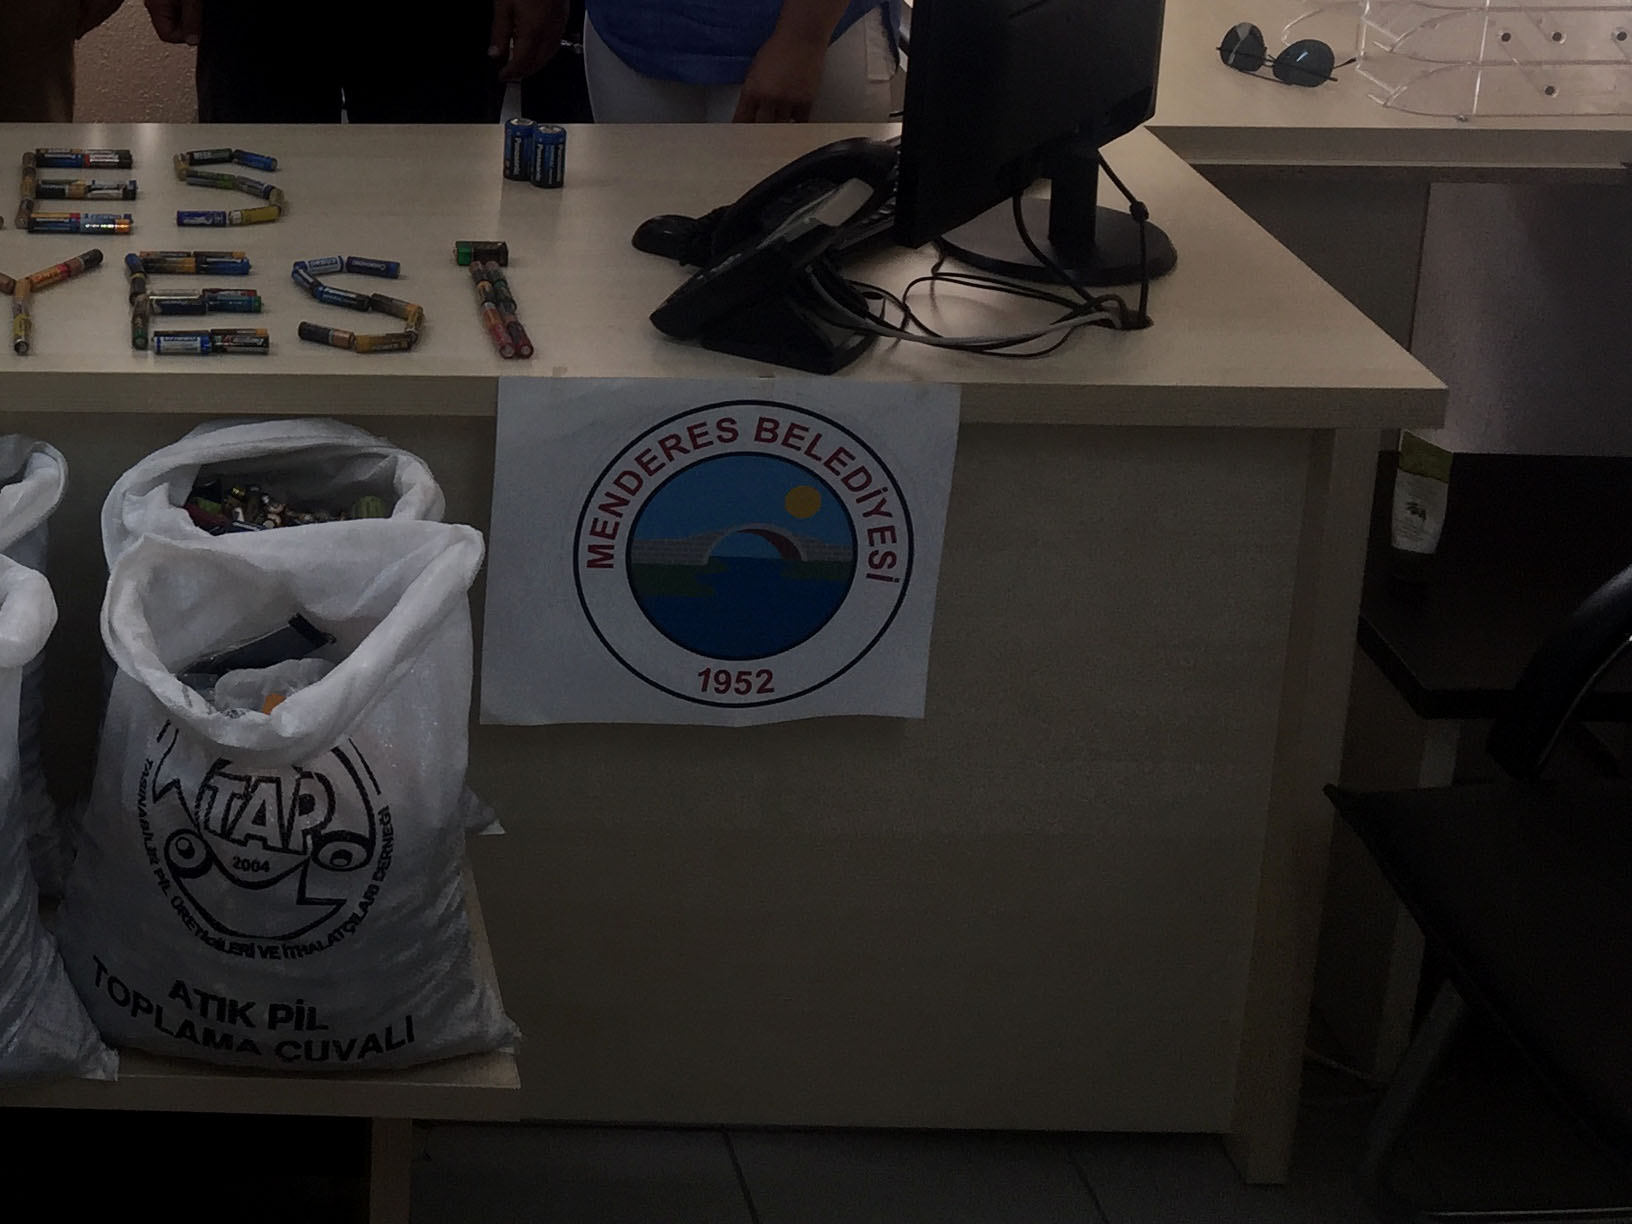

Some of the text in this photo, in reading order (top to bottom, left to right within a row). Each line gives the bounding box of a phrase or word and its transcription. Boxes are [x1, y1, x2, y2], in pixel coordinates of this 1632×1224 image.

[585, 415, 900, 584] MENDERES BELEDİYESİ
[697, 667, 775, 695] 1952
[202, 768, 336, 855] TAP
[232, 856, 270, 873] 2004
[257, 945, 282, 960] VE
[92, 955, 263, 1056] TOPLAMA
[168, 979, 329, 1031] ATIK PİL
